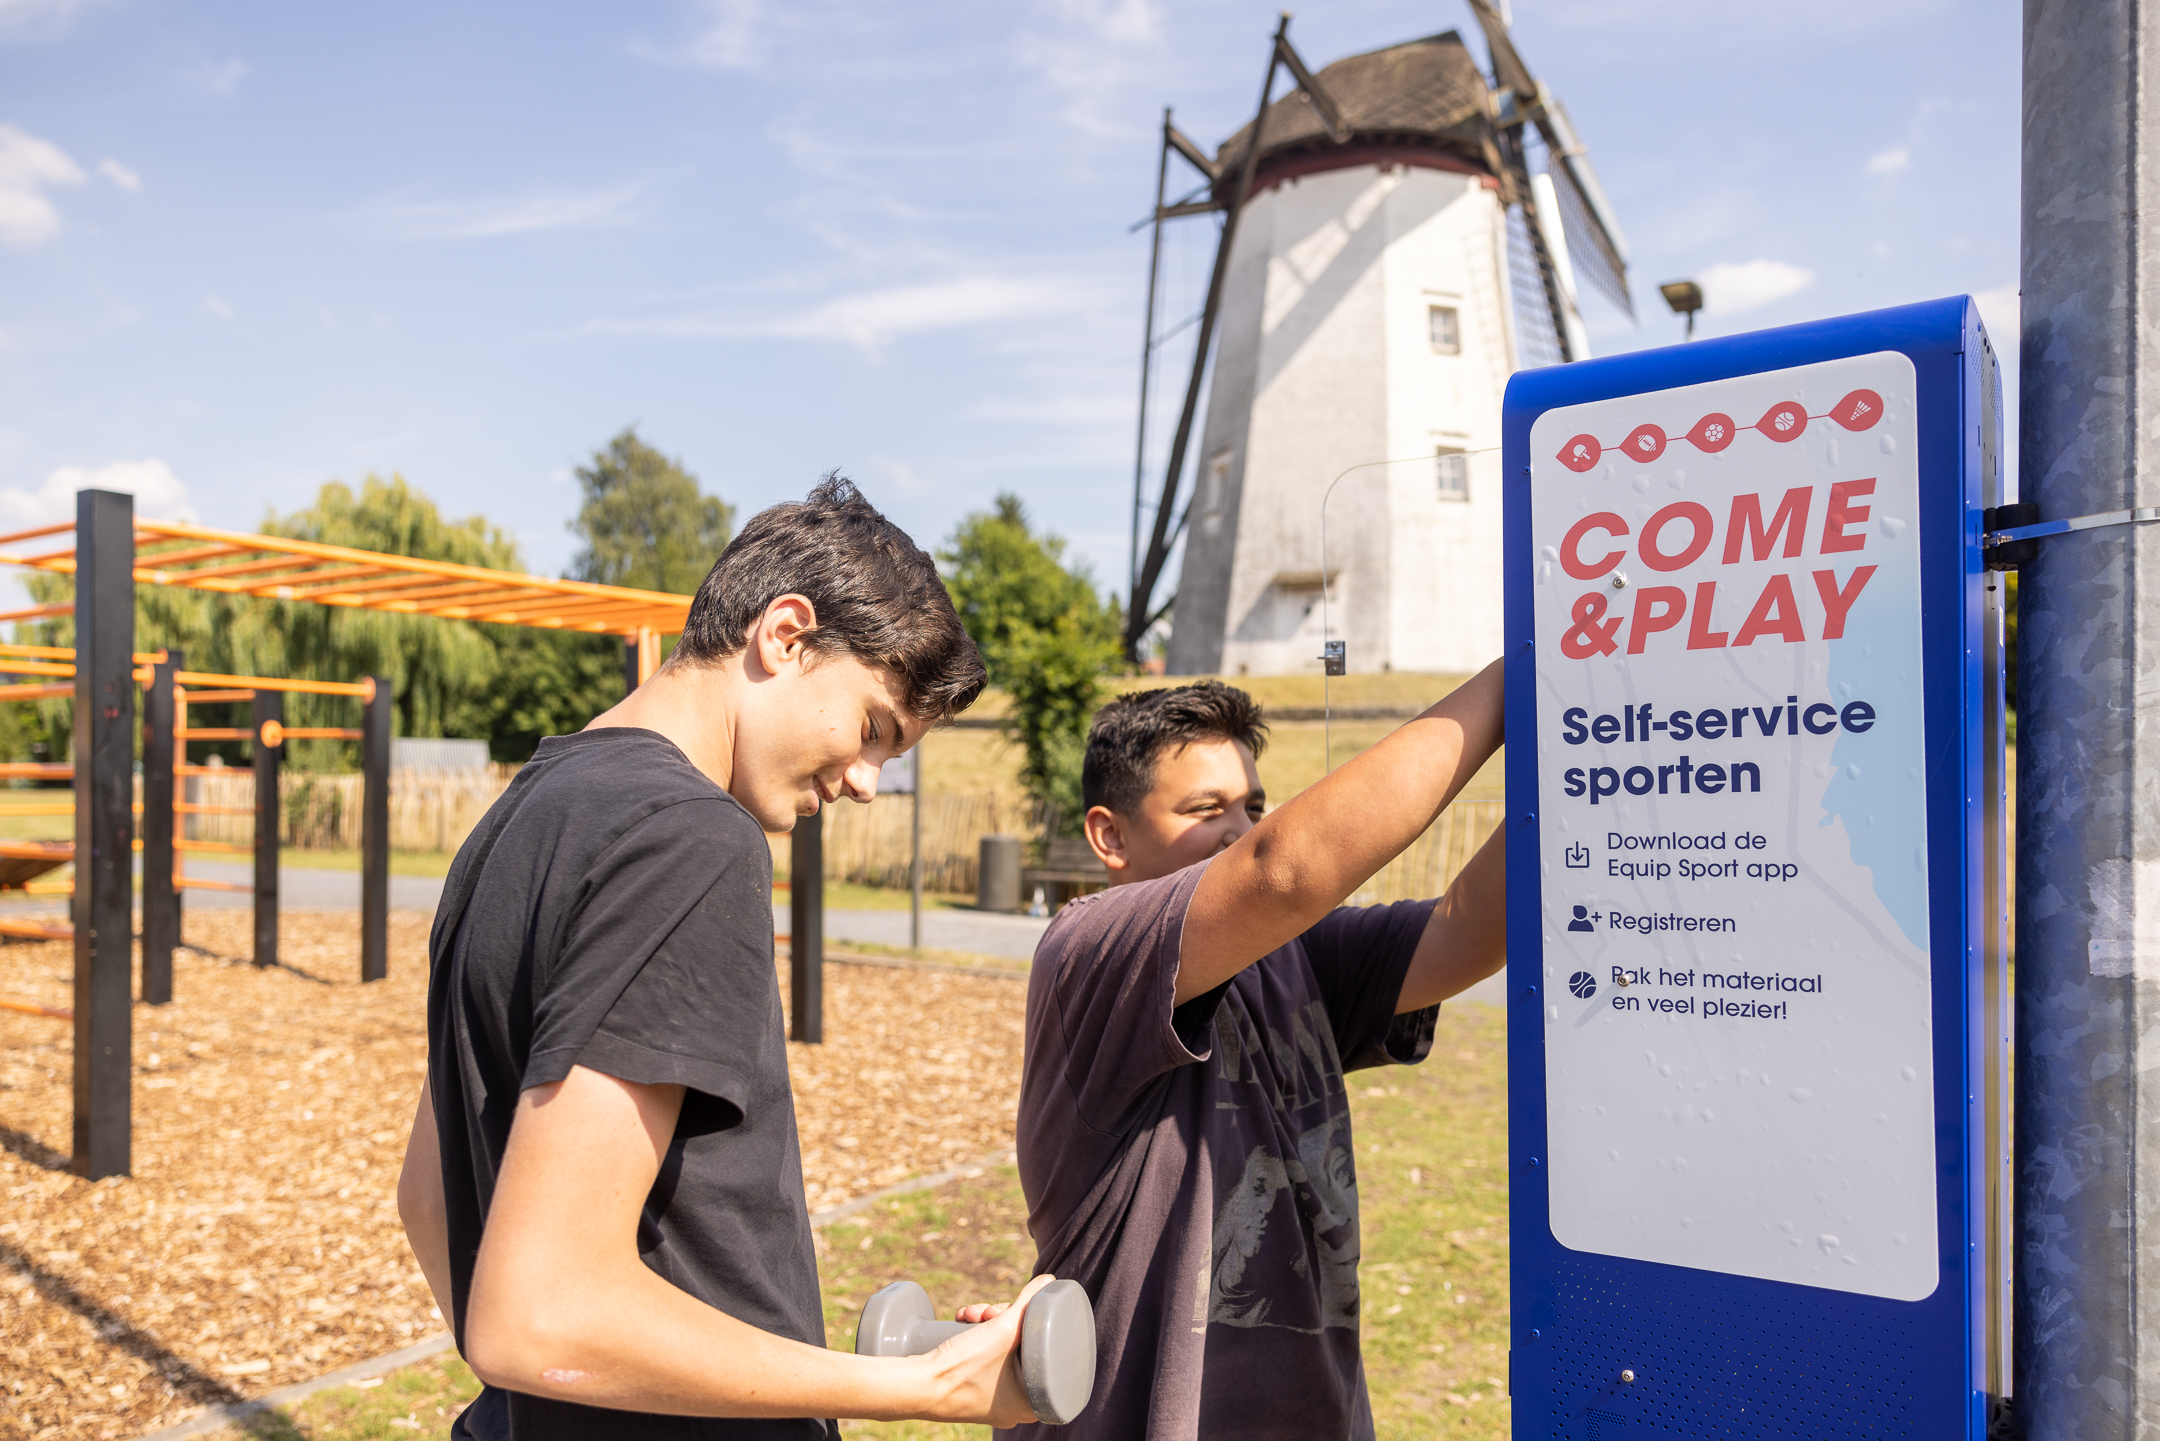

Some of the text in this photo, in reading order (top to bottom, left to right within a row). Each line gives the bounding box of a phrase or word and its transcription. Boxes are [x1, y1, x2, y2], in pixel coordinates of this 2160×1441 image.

[1559, 477, 1877, 581] COME
[1560, 564, 1879, 660] &PLAY
[1562, 695, 1876, 746] Self-service
[1563, 755, 1761, 805] sporten
[1607, 831, 1767, 850] Download de
[1608, 858, 1799, 882] Equip Sport app
[1609, 911, 1736, 935] Registreren
[1611, 965, 1822, 993] Pak het materiaal
[1611, 996, 1787, 1020] en veel plezier!
